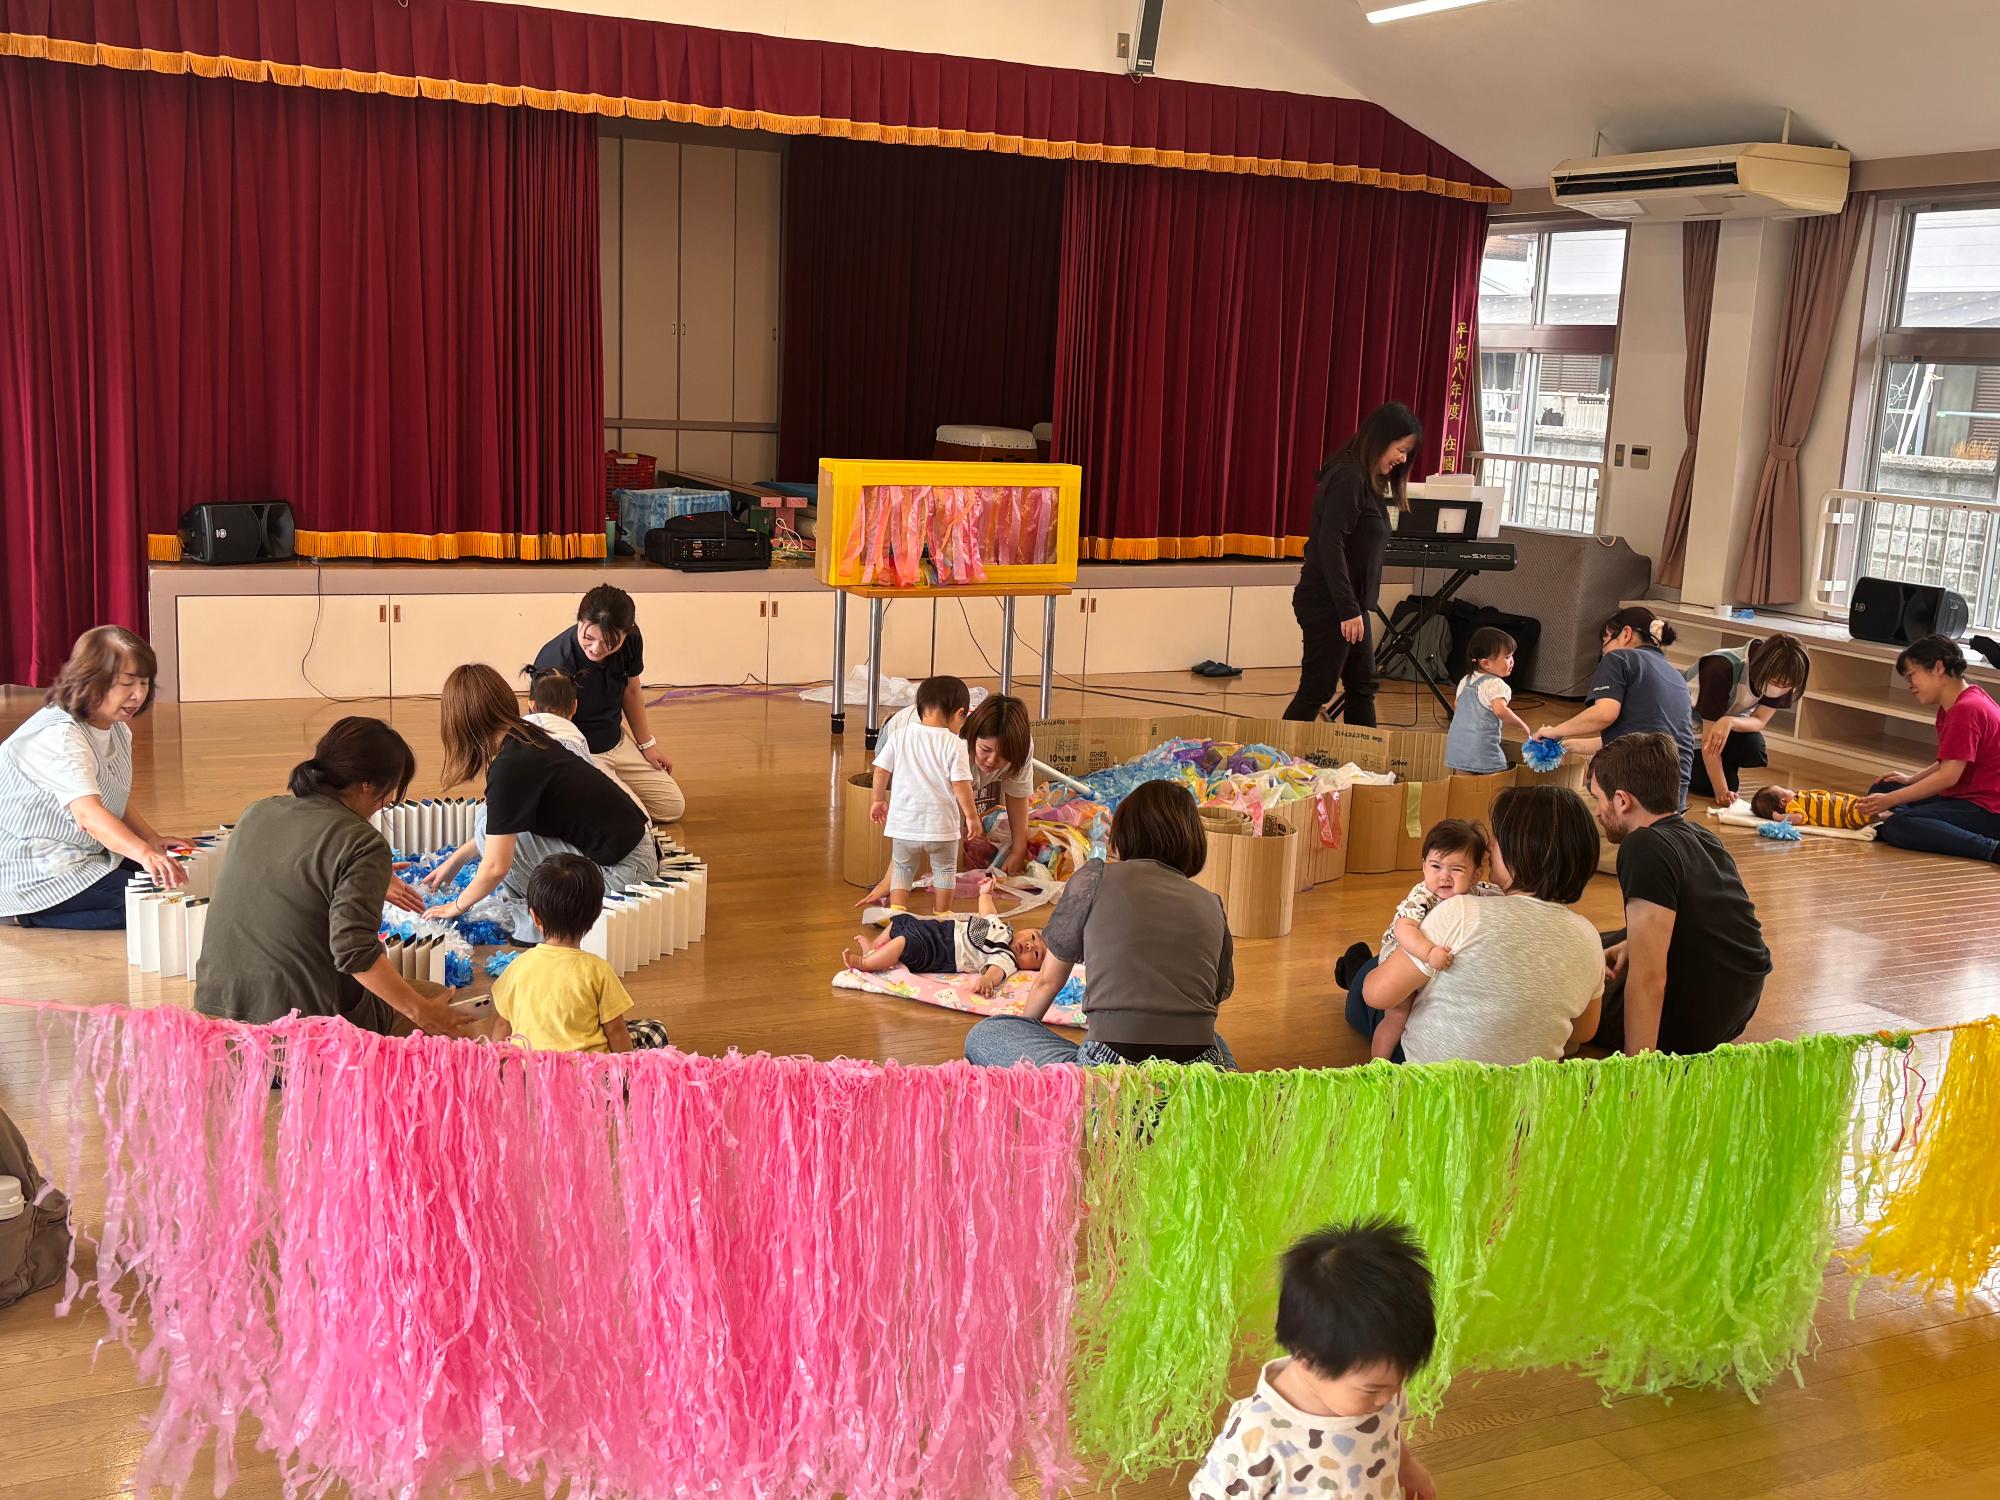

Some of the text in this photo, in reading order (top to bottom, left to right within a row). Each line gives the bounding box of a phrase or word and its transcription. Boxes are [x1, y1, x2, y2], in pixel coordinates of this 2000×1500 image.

[1448, 322, 1469, 420] 平成八年度
